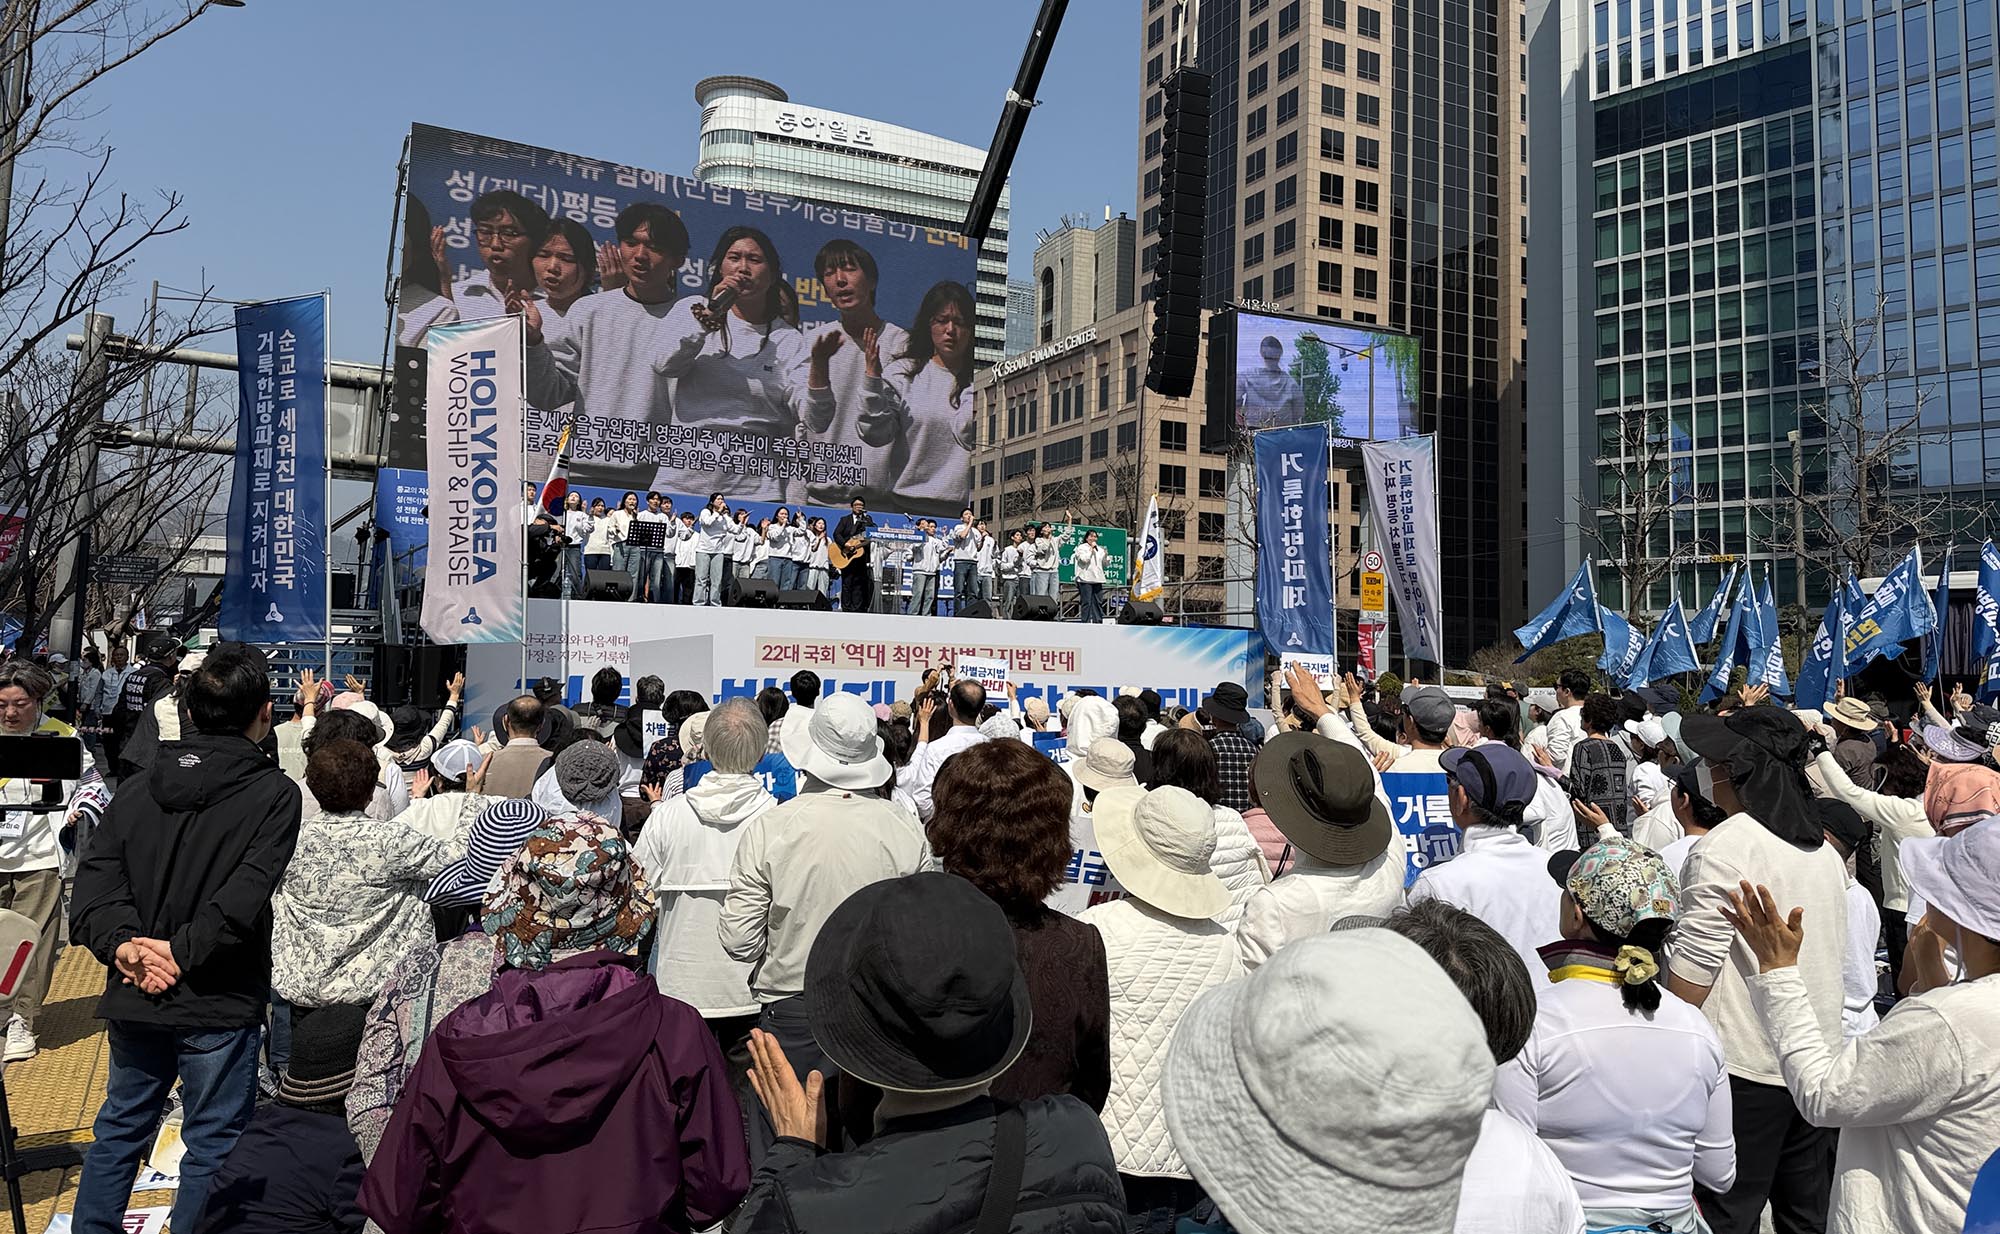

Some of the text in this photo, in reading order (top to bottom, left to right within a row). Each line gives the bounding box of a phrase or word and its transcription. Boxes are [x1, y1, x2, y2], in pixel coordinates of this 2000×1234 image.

[776, 112, 874, 147] 동아일보
[1240, 298, 1280, 313] 서울신문
[1004, 358, 1029, 373] SEOUL
[1030, 341, 1064, 365] FINANCE
[1065, 328, 1096, 351] CENTER
[526, 409, 542, 429] 든
[593, 417, 650, 441] 구원하려
[656, 424, 697, 447] 영광의
[700, 430, 715, 449] 주
[717, 432, 768, 454] 예수님이
[772, 438, 810, 458] 죽음을
[813, 443, 862, 464] 택하셨네
[250, 332, 274, 593] 거룩한방파제로 지켜내자
[272, 329, 297, 590] 순교로 세워진 대한민국
[448, 353, 469, 586] WORSHIP & PRAISE
[469, 350, 497, 584] HOLYKOREA
[577, 438, 593, 459] 뜻
[596, 441, 654, 465] 기억하사
[656, 447, 686, 468] 길을
[688, 450, 716, 471] 잃은
[719, 453, 745, 474] 우릴
[749, 457, 774, 477] 위해
[778, 462, 828, 483] 십자가를
[830, 467, 867, 487] 지셨네
[1367, 556, 1379, 567] 50
[583, 635, 630, 647] 다음세대
[762, 644, 800, 664] 22대
[803, 645, 835, 665] 국회
[893, 645, 932, 668] 최악
[1040, 650, 1075, 672] 반대
[596, 652, 630, 665] 거룩한
[959, 664, 1006, 679] 차별금지법
[1283, 661, 1329, 673] 차금지법
[982, 680, 1004, 692] 반대
[645, 722, 677, 737] 차별금
[1397, 794, 1454, 828] 거룩
[1400, 832, 1462, 868] 방파
